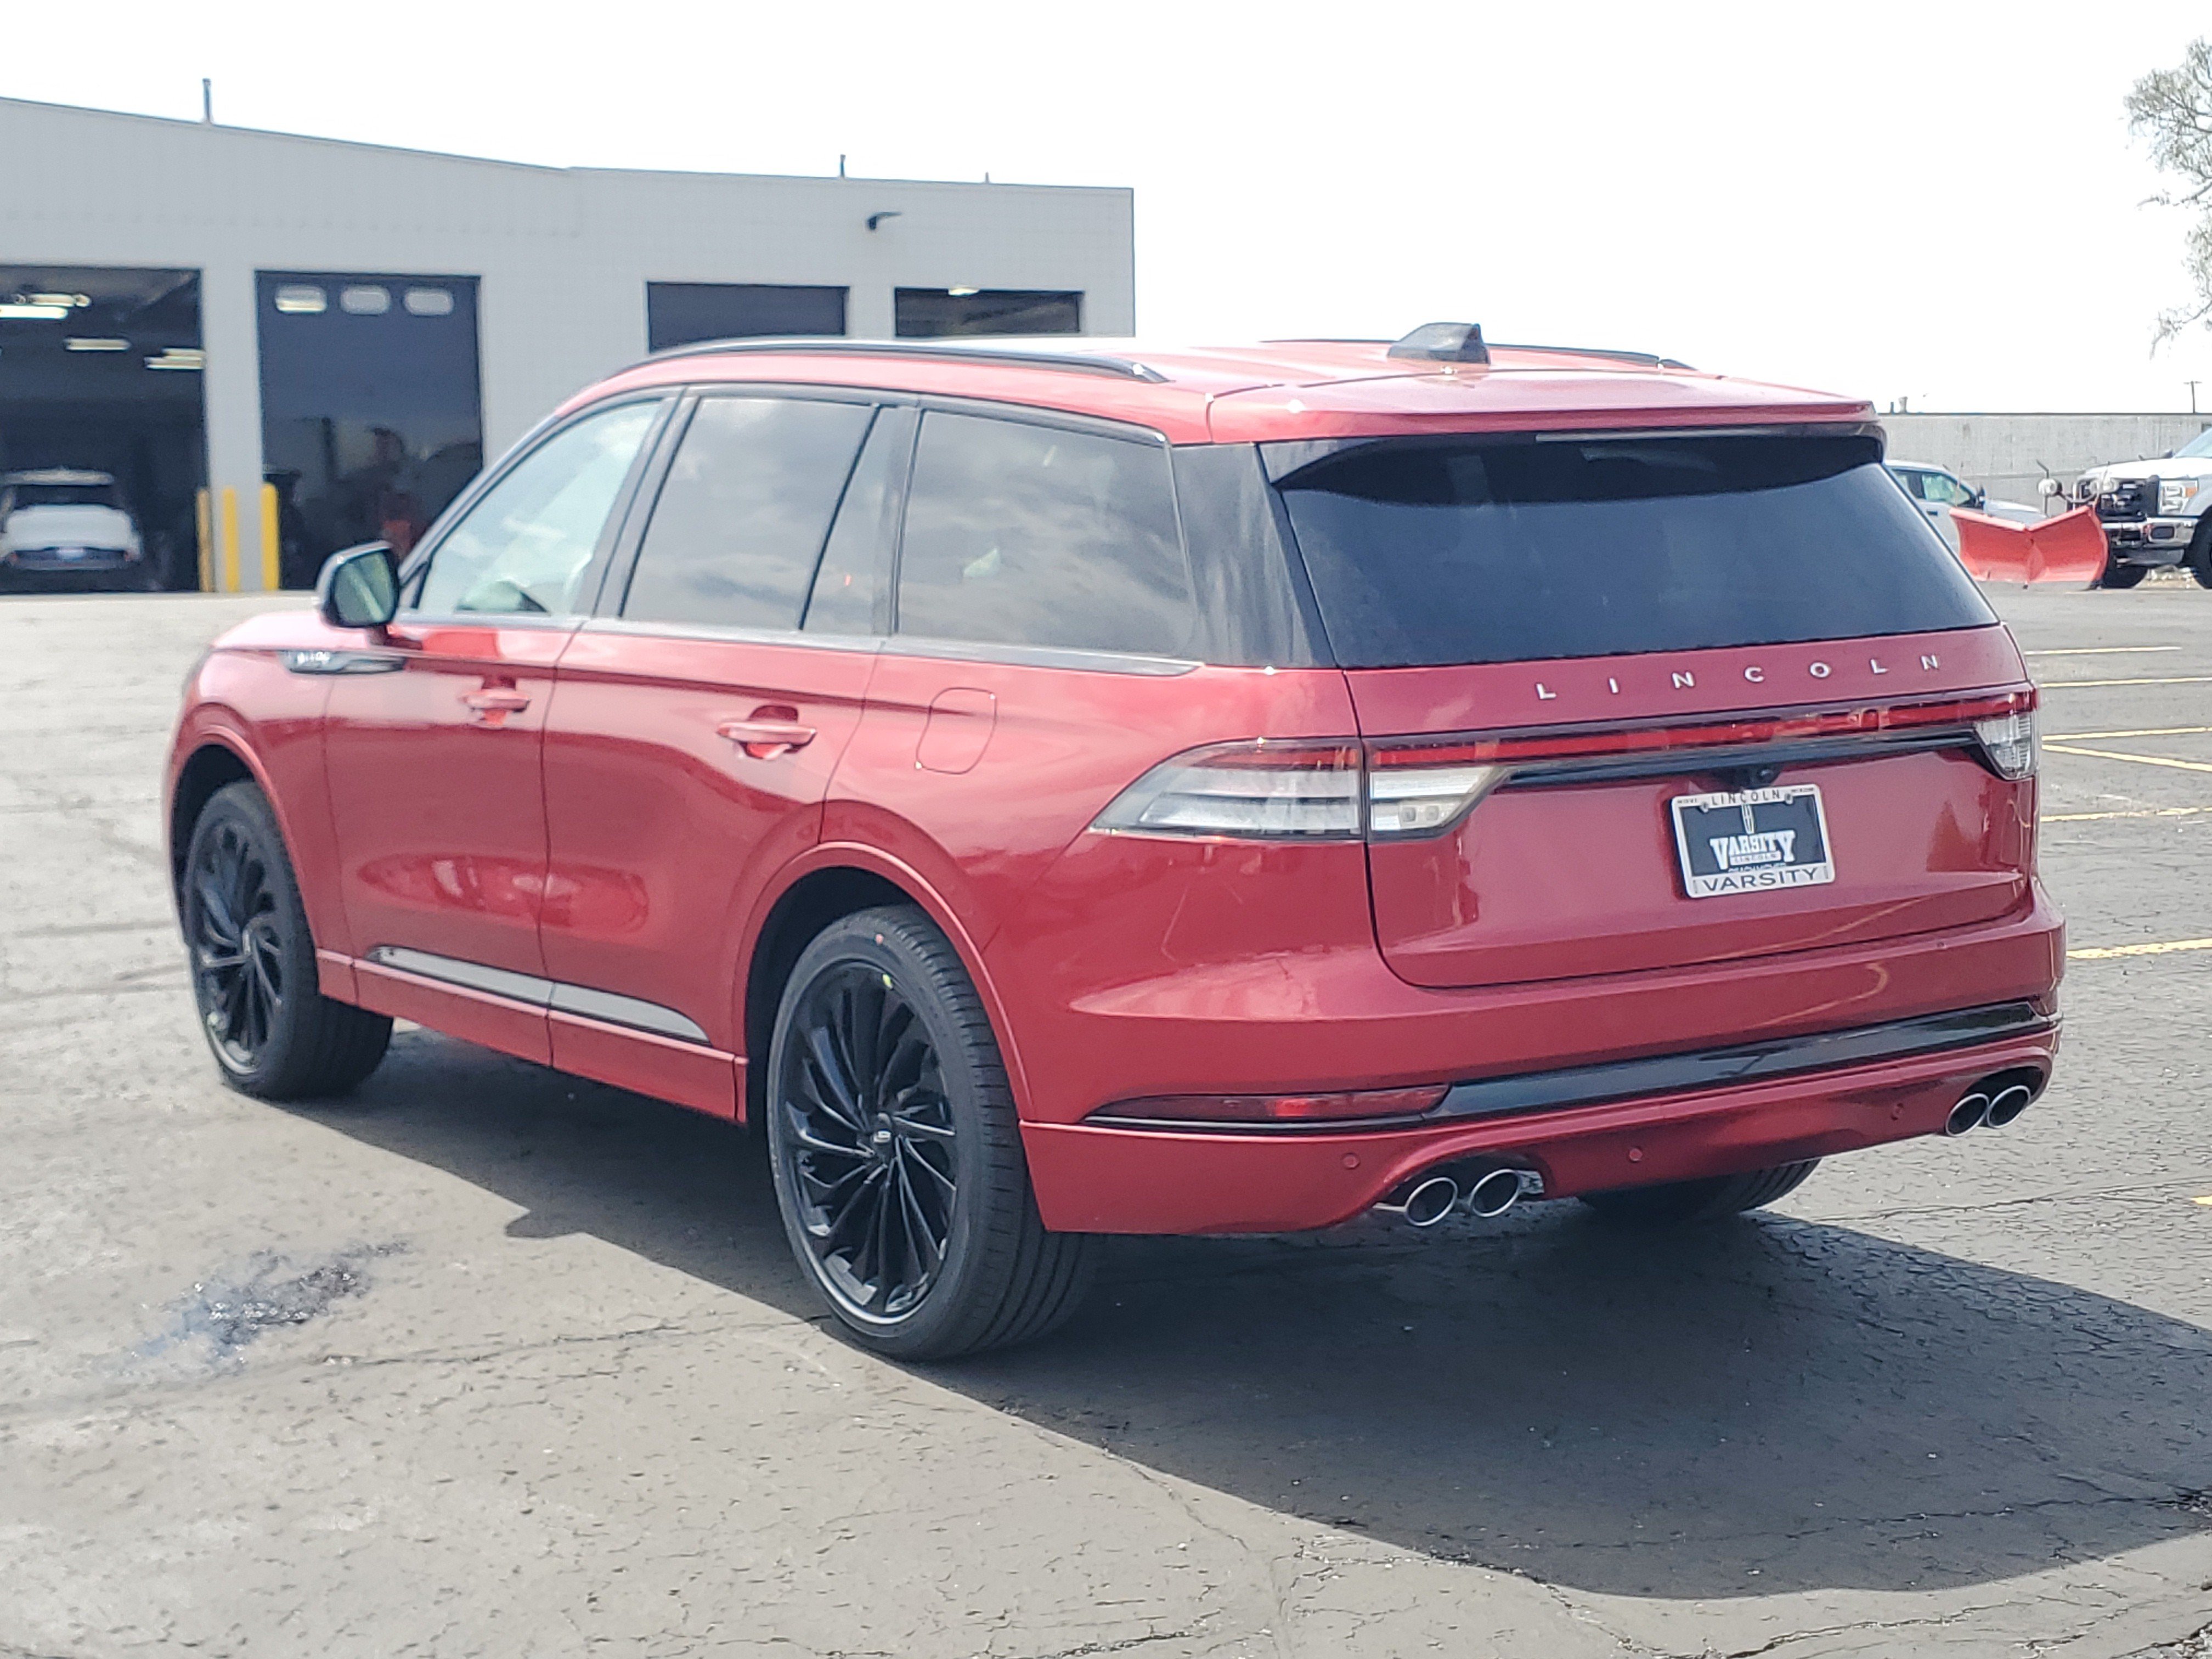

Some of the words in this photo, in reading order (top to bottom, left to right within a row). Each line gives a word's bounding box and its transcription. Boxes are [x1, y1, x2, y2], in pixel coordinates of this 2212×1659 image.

[1536, 654, 1938, 701] LINCOLN
[1711, 789, 1780, 805] LINCOLN
[1709, 830, 1796, 870] VARSITY
[1703, 867, 1818, 891] VARSITY
